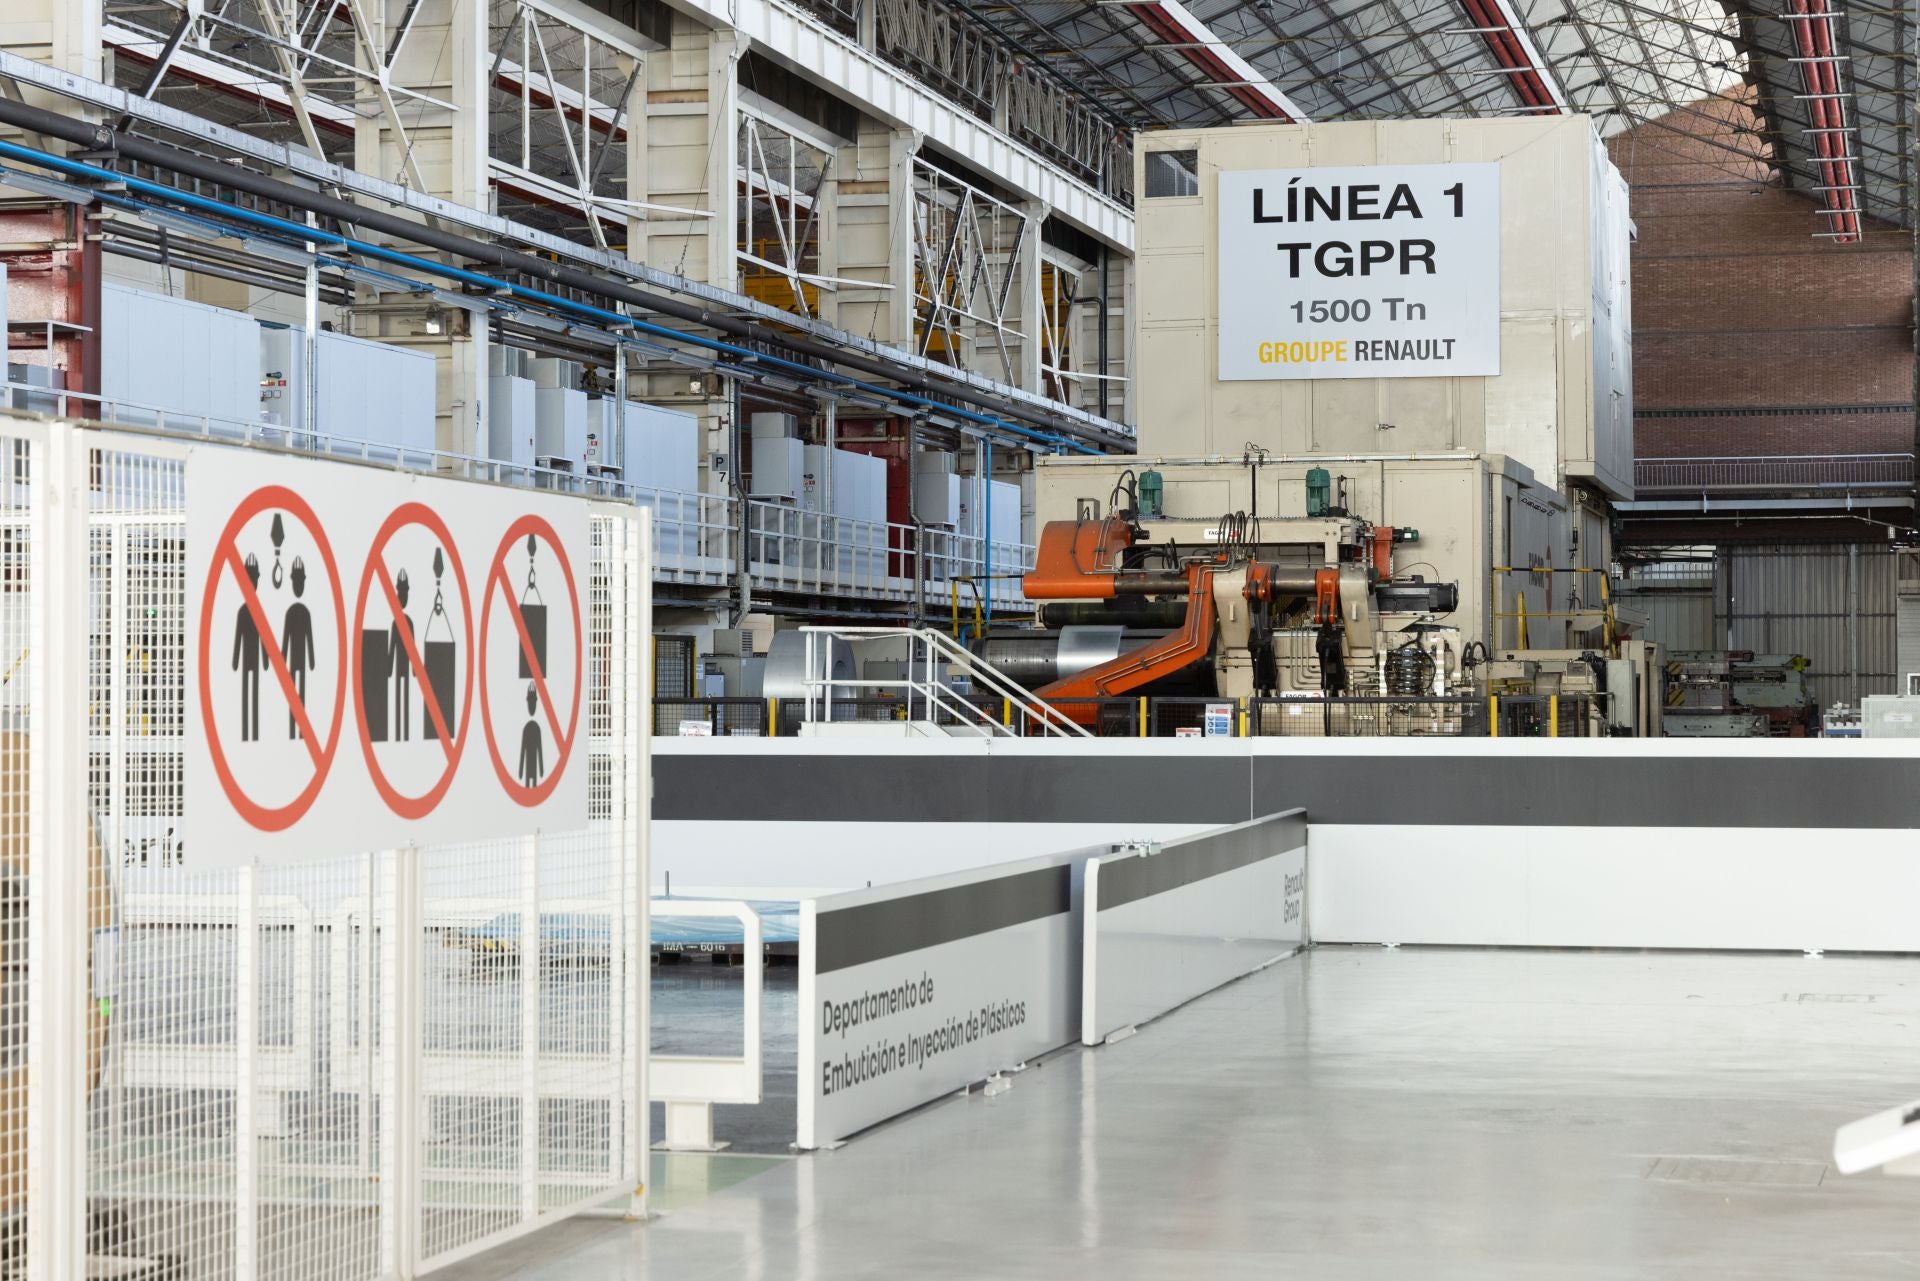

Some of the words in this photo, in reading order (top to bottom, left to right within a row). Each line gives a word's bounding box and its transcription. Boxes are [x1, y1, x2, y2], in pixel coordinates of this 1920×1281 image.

[1253, 177, 1423, 224] LÍNEA
[1443, 183, 1463, 218] 1
[1277, 239, 1437, 279] TGPR
[1290, 299, 1371, 323] 1500
[1382, 298, 1427, 321] Tn
[1258, 340, 1348, 364] GROUPE
[1355, 339, 1456, 361] RENAULT
[715, 456, 724, 468] P
[719, 471, 726, 483] 7
[823, 980, 917, 1039] Departamento
[919, 971, 934, 1006] de
[823, 1038, 896, 1096] Embutición
[898, 1041, 905, 1068] e
[908, 1016, 964, 1070] Inyección
[966, 1010, 979, 1043] de
[981, 998, 1026, 1037] Plásticos
